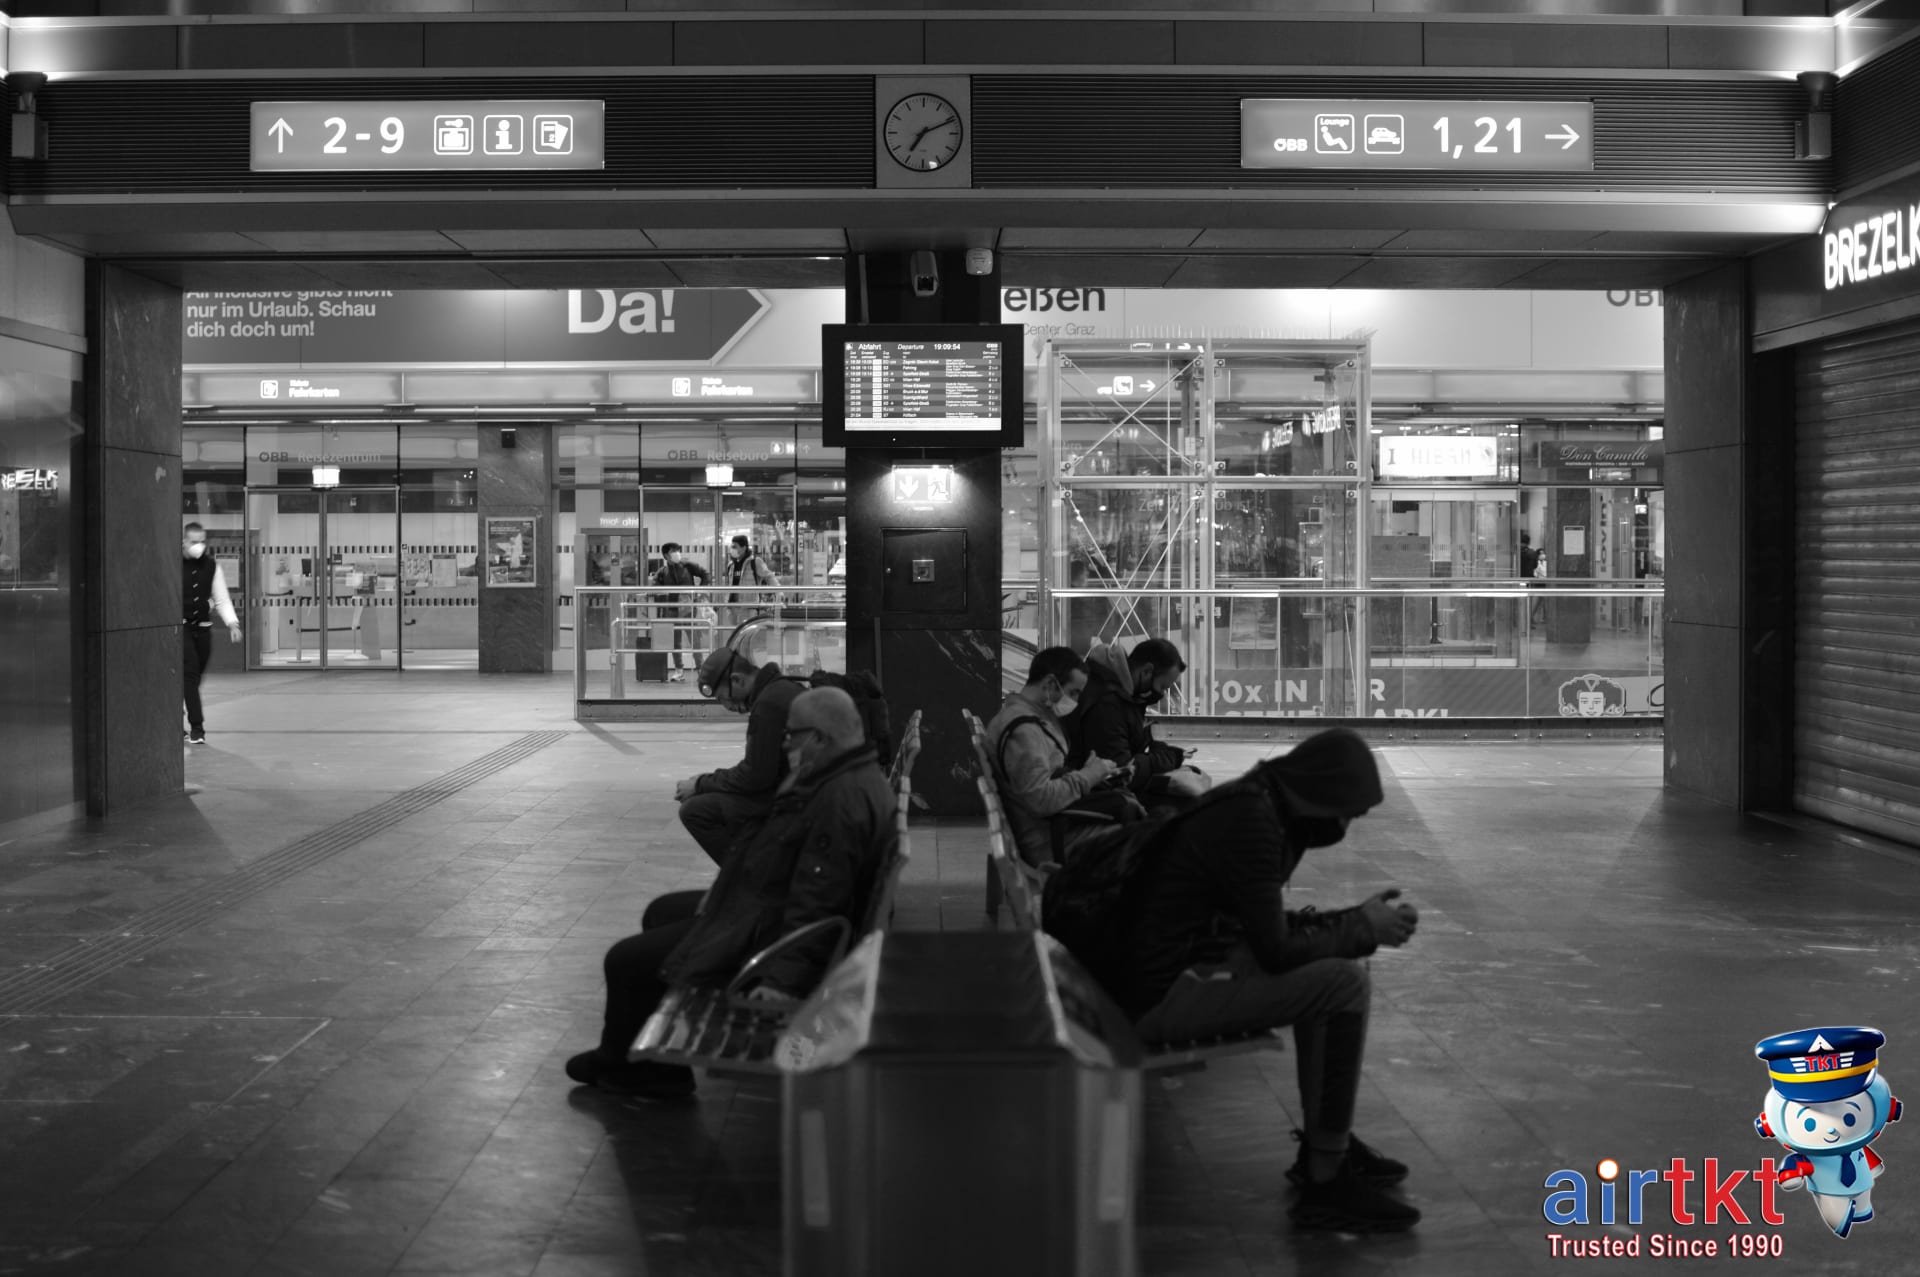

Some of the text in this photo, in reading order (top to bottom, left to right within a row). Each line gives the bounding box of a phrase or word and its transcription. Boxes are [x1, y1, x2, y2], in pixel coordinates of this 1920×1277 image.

[1319, 117, 1350, 127] Lounge
[187, 300, 376, 318] nur im Urlaub. Schau
[187, 320, 315, 337] dich doch um!
[1065, 322, 1096, 336] Graz
[1274, 679, 1308, 703] IN
